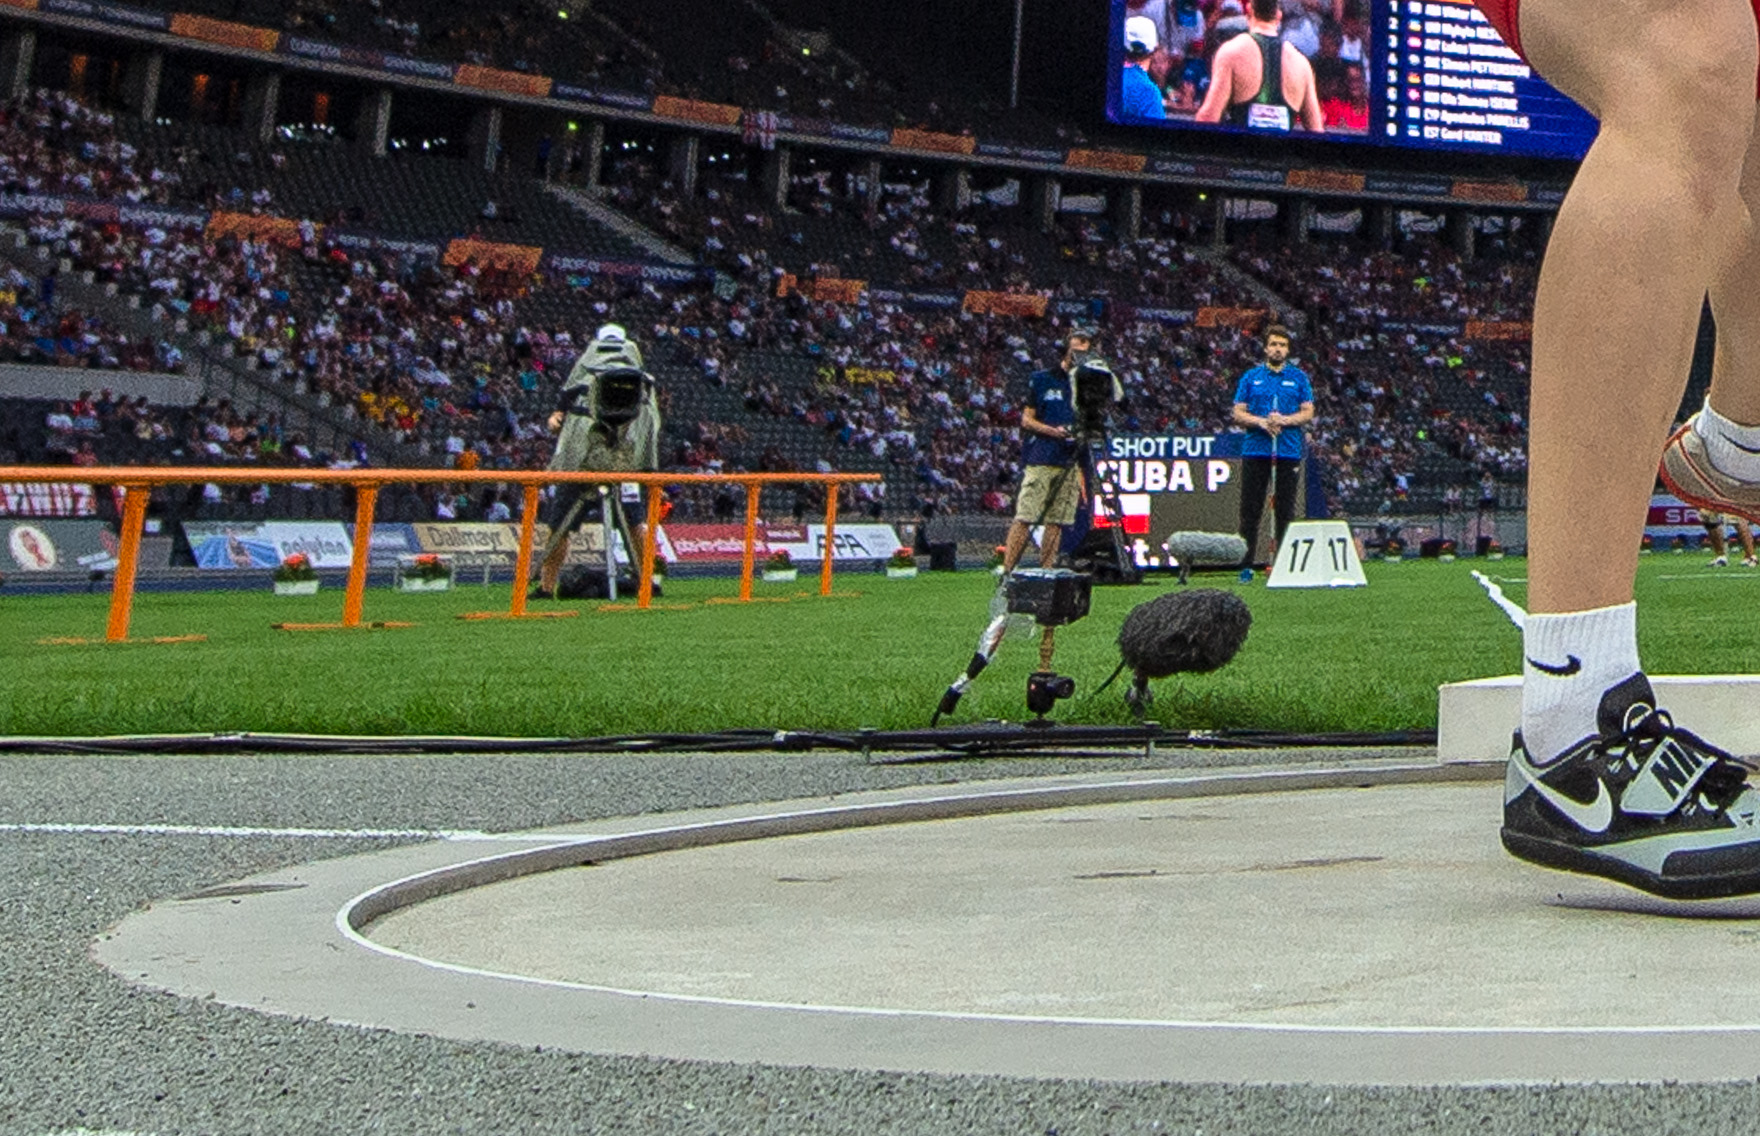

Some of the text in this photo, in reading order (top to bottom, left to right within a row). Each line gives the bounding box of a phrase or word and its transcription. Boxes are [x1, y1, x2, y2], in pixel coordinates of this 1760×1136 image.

[1111, 437, 1215, 458] SHOT PUT
[1207, 460, 1231, 492] P
[427, 526, 503, 551] Dallmayr
[1327, 537, 1349, 572] 17
[1290, 538, 1315, 572] 17
